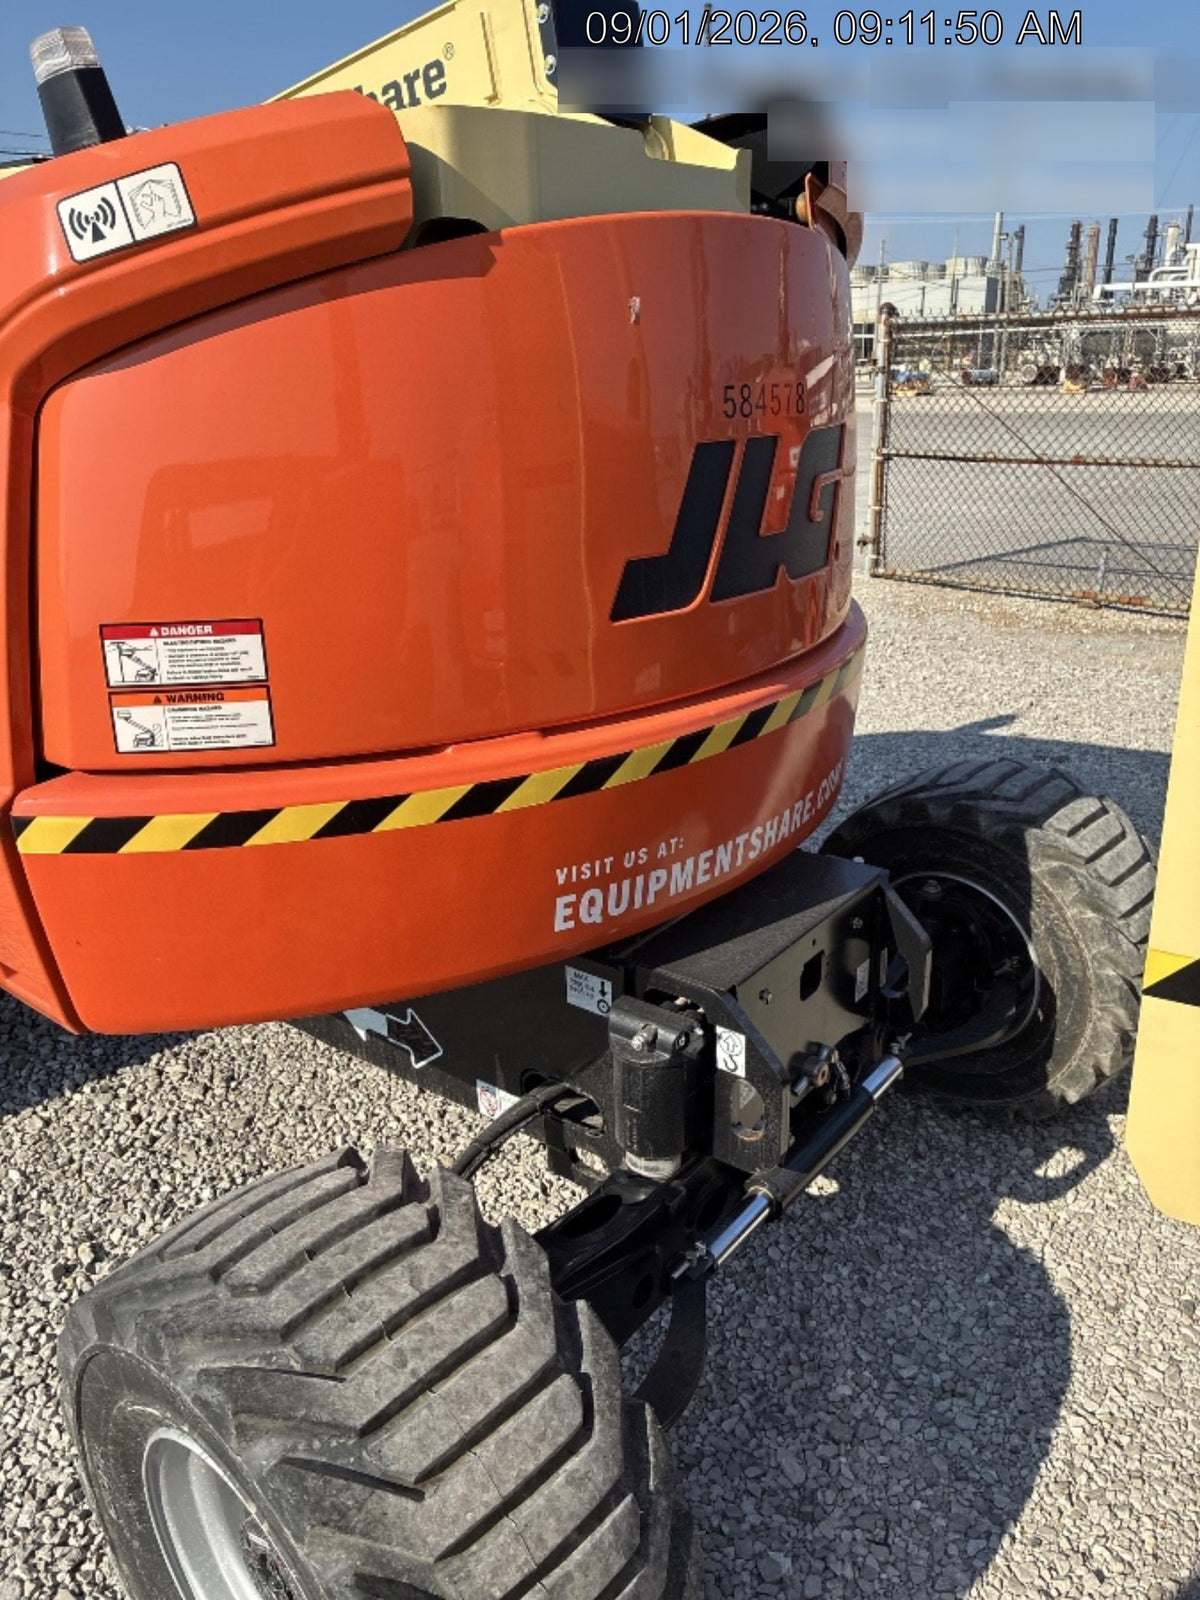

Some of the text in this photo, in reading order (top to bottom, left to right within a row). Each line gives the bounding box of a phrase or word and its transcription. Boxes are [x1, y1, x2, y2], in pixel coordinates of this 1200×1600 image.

[723, 382, 805, 419] 584578
[610, 423, 846, 622] JLG
[161, 625, 213, 636] DANGER
[166, 692, 225, 703] WARNING
[556, 837, 683, 885] VISIT US AT:
